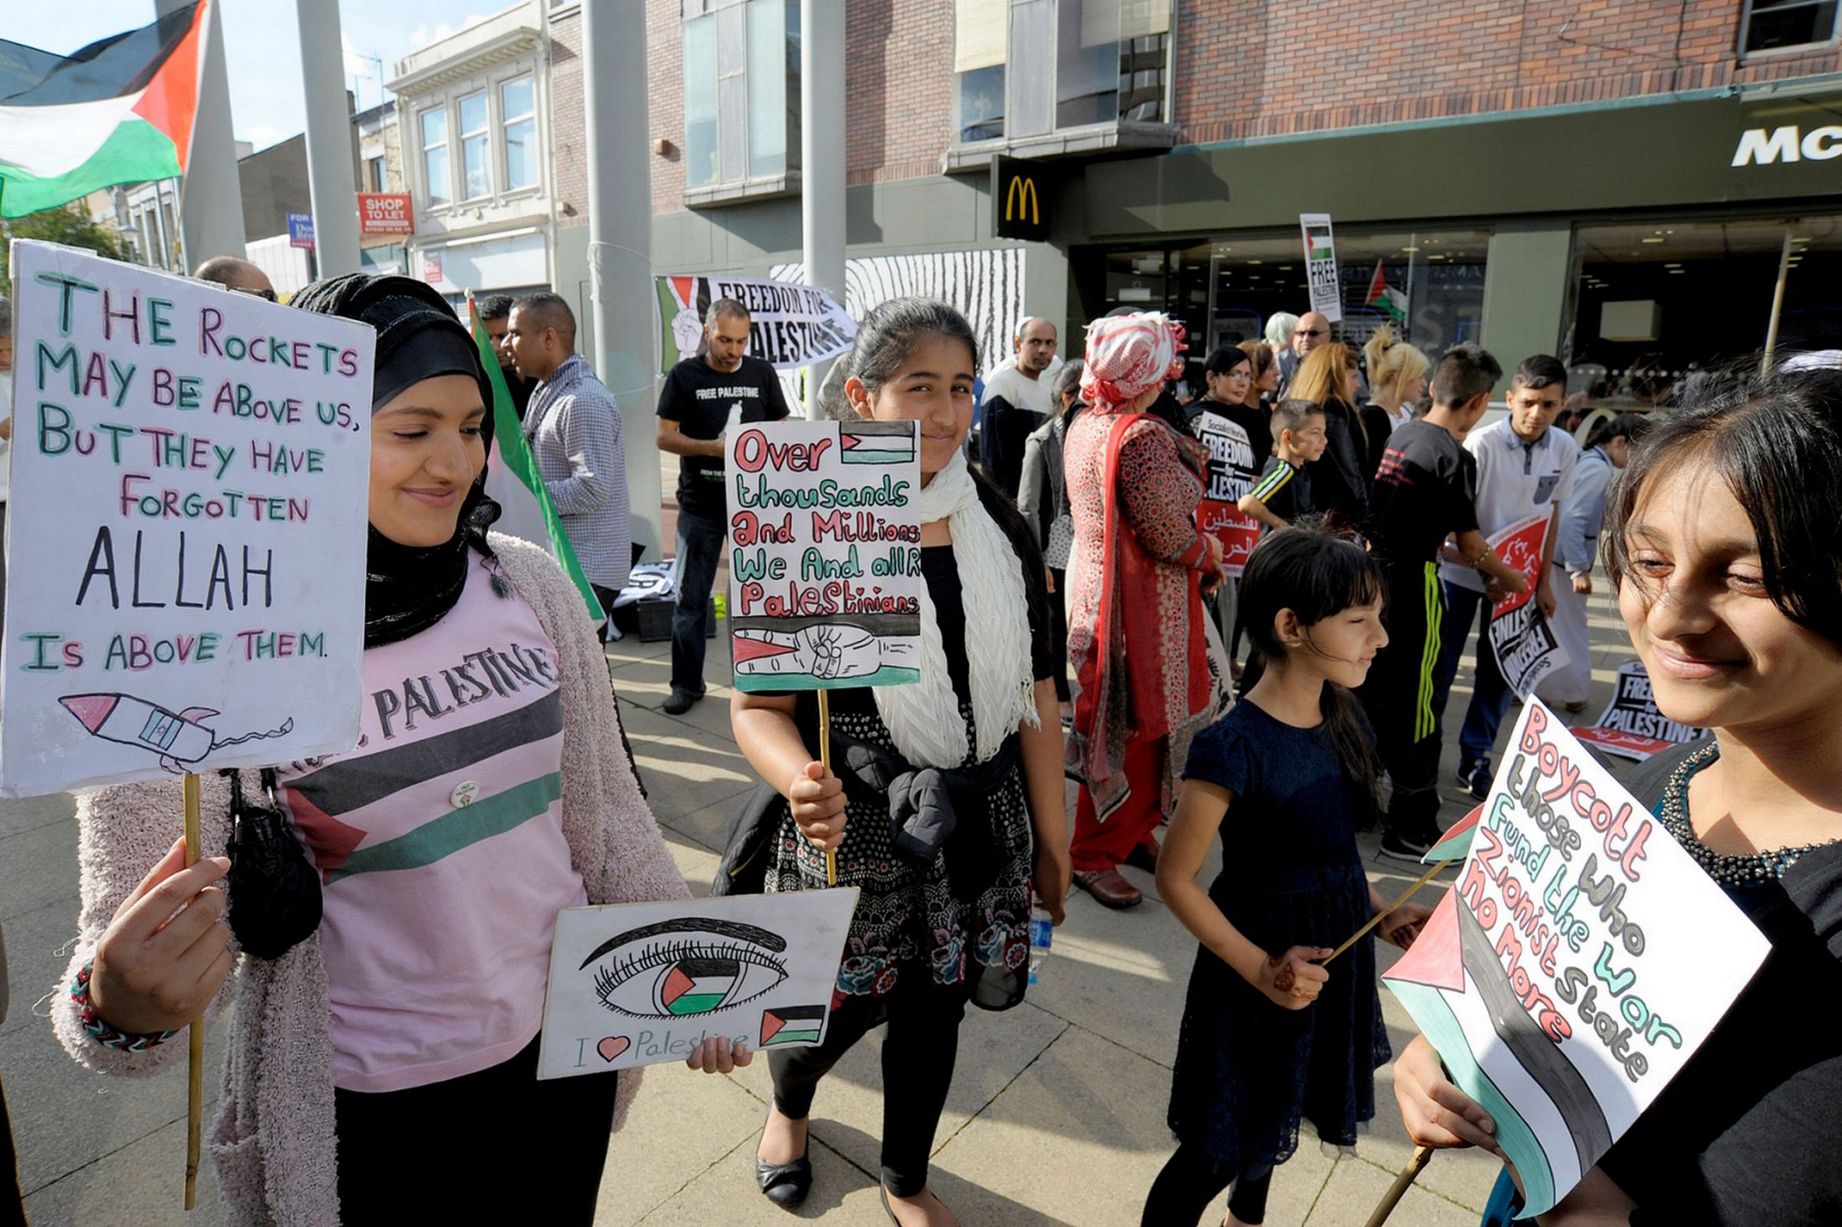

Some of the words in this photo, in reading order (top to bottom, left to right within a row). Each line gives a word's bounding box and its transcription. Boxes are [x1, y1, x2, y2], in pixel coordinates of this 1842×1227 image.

[366, 198, 404, 210] SHOP
[367, 210, 383, 219] TO
[385, 210, 405, 219] LET
[1310, 260, 1335, 286] FREE
[718, 282, 803, 314] FREEDOM
[804, 290, 833, 316] FOR
[37, 274, 176, 347] THE
[200, 307, 358, 377] ROCKETS
[750, 319, 854, 363] ALESTINE
[37, 342, 136, 408] MAY
[153, 369, 201, 410] BE
[213, 382, 302, 424] ABOVE
[696, 388, 717, 400] FREE
[718, 386, 759, 398] PALESTINE
[140, 427, 235, 479] THEY
[251, 439, 325, 473] HAVE
[734, 429, 832, 473] Over
[1203, 432, 1253, 469] FREEDOM
[120, 474, 310, 521] FORGOTTEN
[812, 509, 920, 543] Millions
[75, 526, 272, 610] ALLAH
[733, 547, 787, 582] We
[23, 633, 83, 671] IS
[105, 632, 220, 671] ABOVE
[370, 643, 557, 741] PALESTINE
[1520, 703, 1652, 882] Boycott
[1507, 754, 1581, 862] those
[1578, 854, 1646, 956] Who
[1488, 792, 1552, 882] Fund
[1544, 864, 1590, 953] the
[1593, 941, 1682, 1050] War
[1476, 826, 1560, 978] Zionist
[1555, 966, 1649, 1083] State
[1496, 923, 1572, 1044] More
[574, 1038, 590, 1067] I
